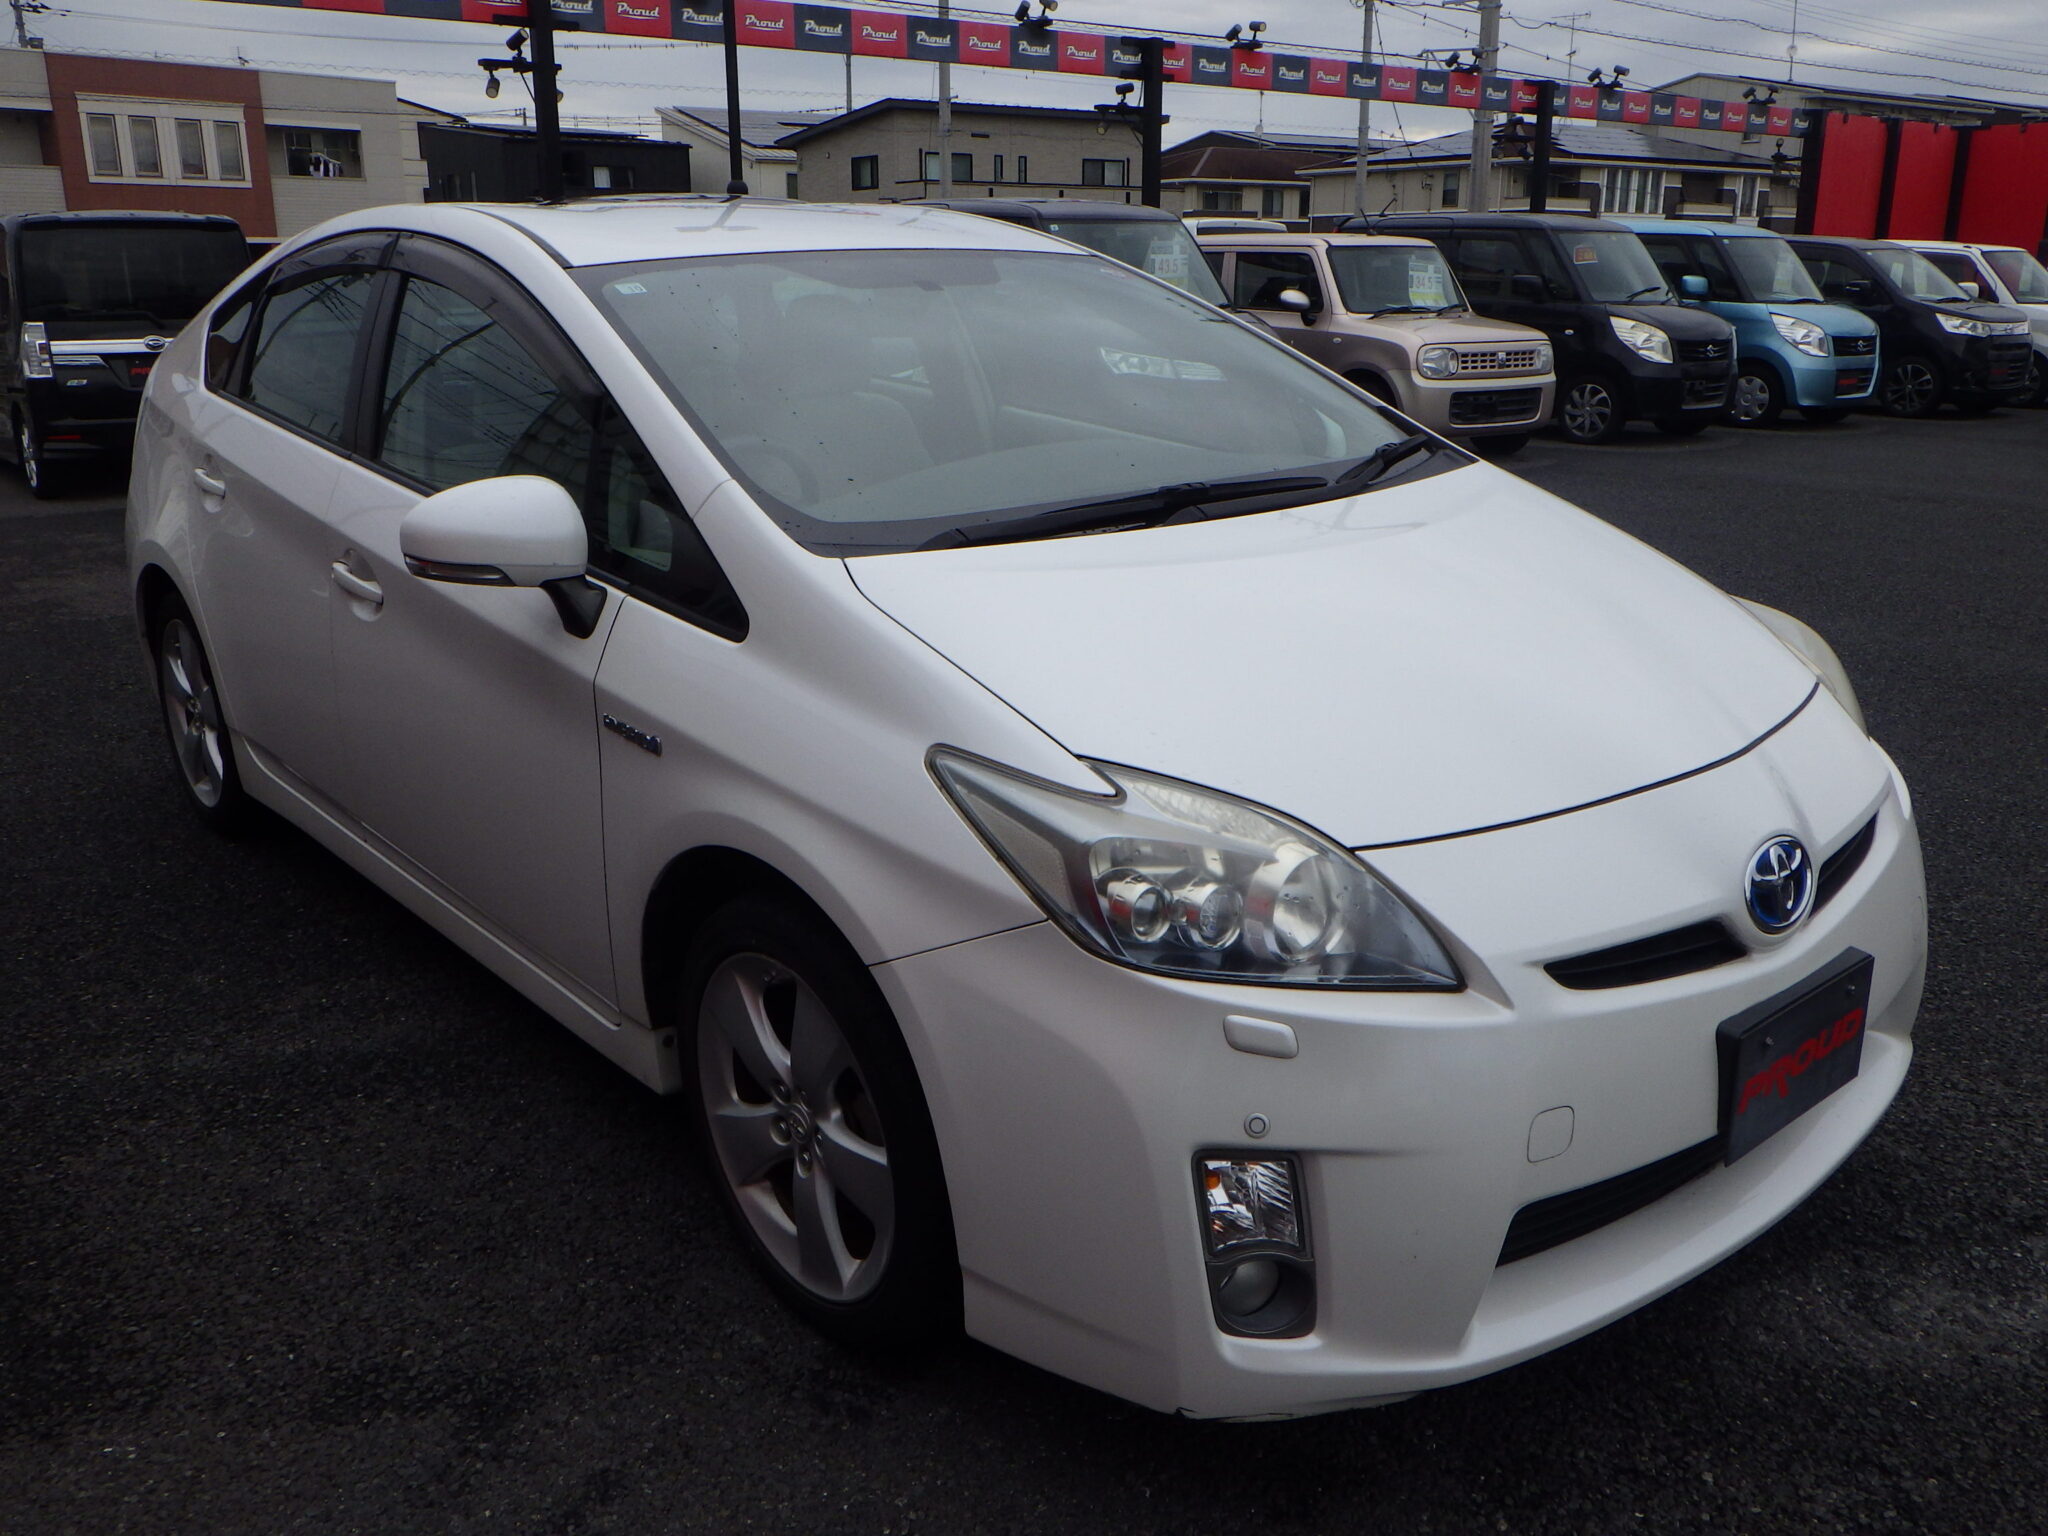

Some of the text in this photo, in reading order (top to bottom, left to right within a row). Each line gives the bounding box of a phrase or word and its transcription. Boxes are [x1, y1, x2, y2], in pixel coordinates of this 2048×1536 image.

[617, 2, 659, 17] Proud
[682, 8, 723, 23] Proud
[745, 14, 784, 28] Proud
[804, 19, 842, 34] Proud
[862, 25, 898, 39] Proud
[916, 31, 951, 45] Proud
[969, 36, 1002, 50] Proud
[1018, 41, 1050, 54] Proud
[1066, 46, 1097, 58] Proud
[1112, 49, 1142, 62] Proud
[1163, 56, 1185, 67] roud
[1198, 59, 1226, 71] Proud
[1240, 63, 1266, 74] Proud
[1279, 66, 1304, 79] Proud
[1316, 70, 1341, 82] Proud
[1736, 1008, 1864, 1116] PROUD
